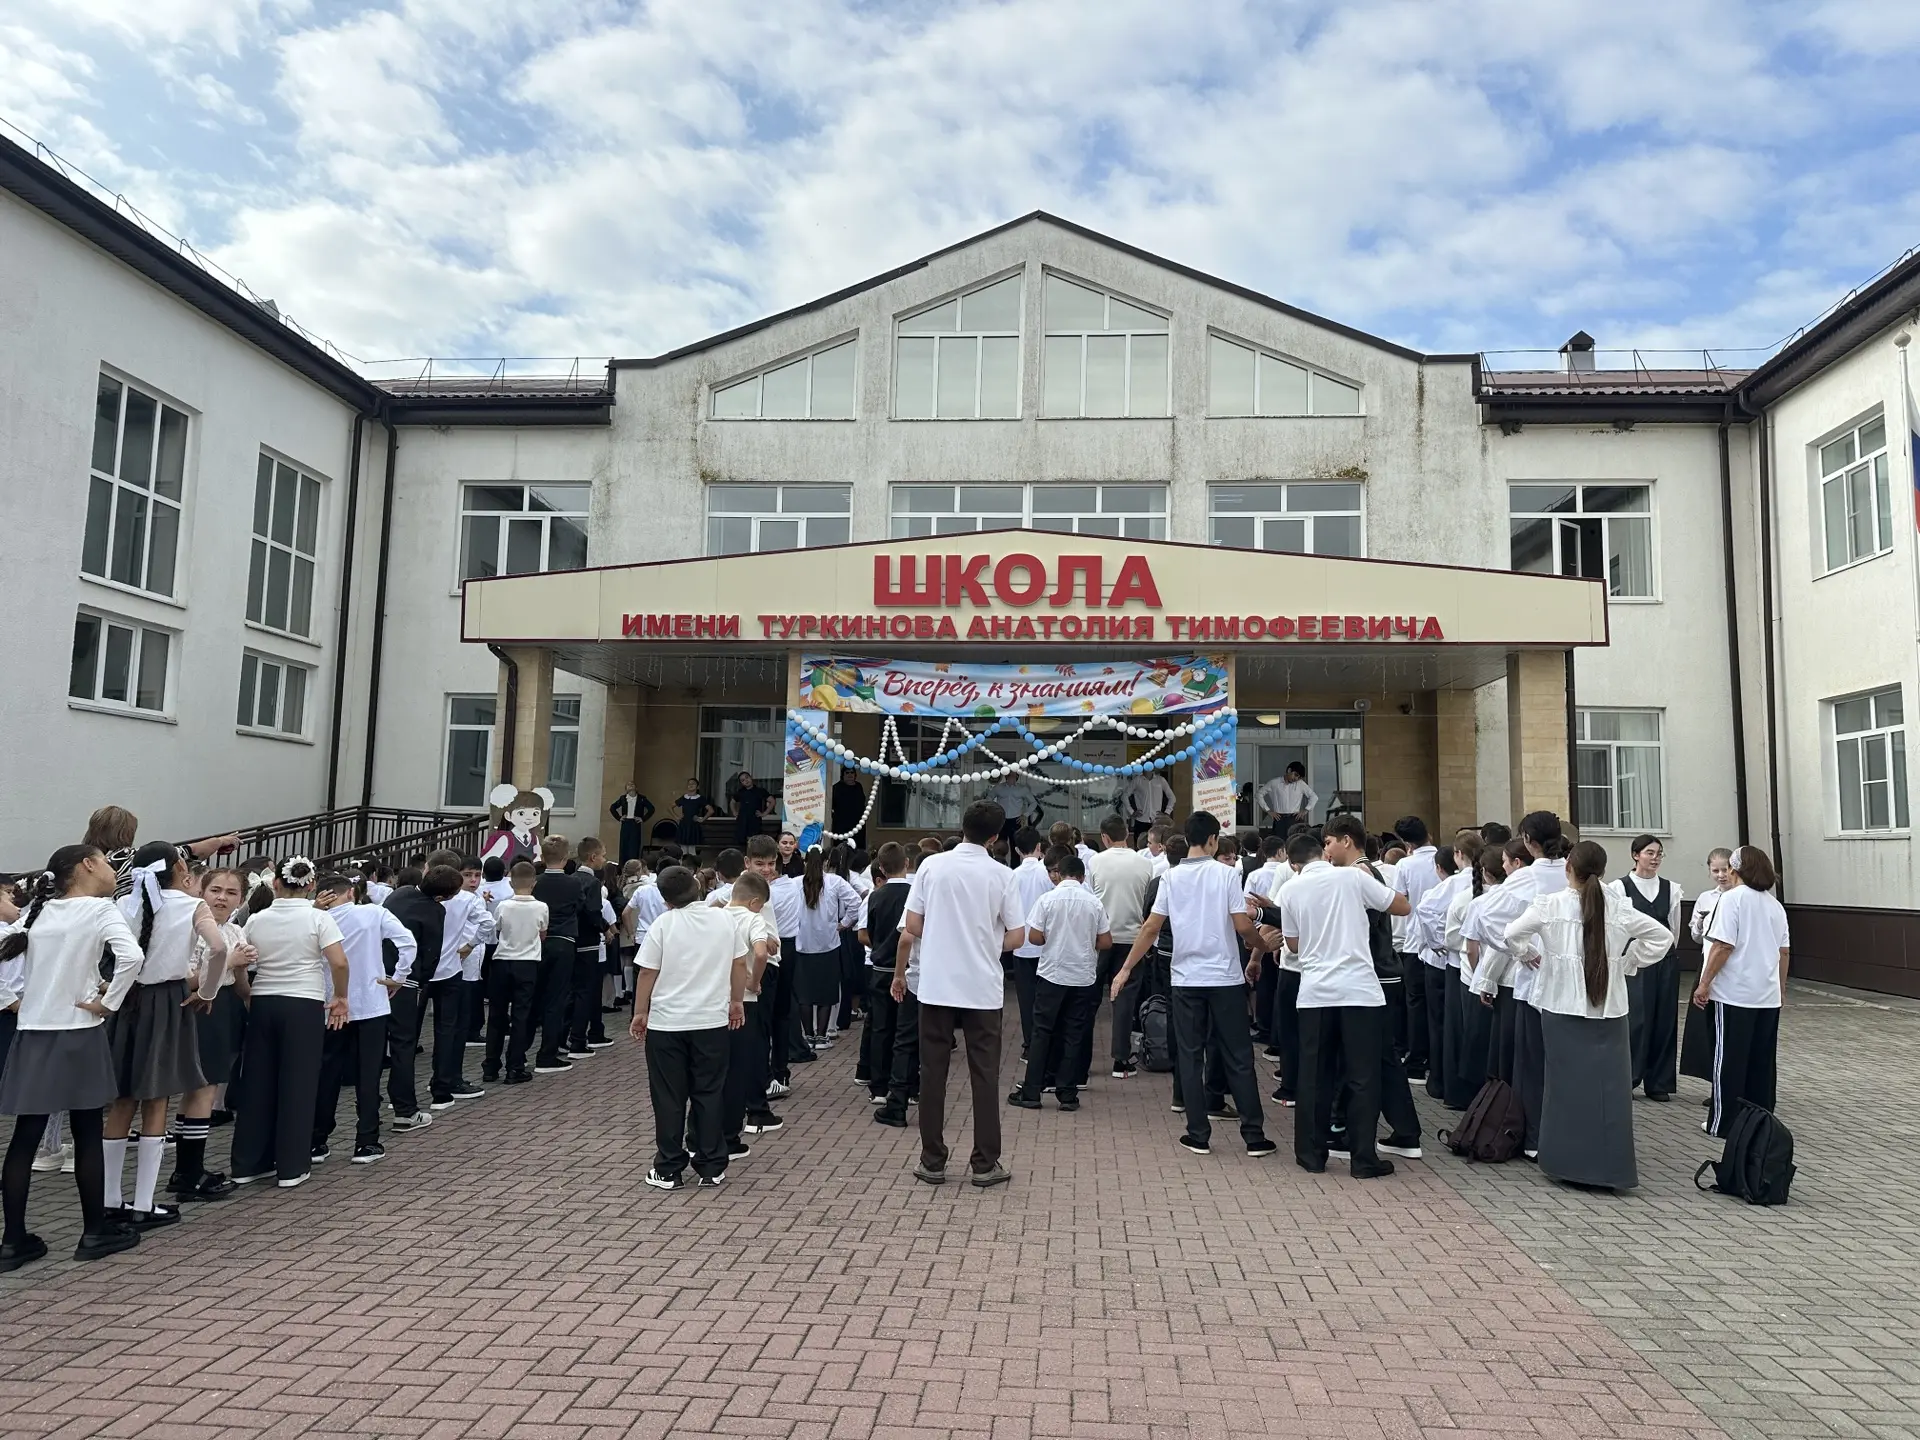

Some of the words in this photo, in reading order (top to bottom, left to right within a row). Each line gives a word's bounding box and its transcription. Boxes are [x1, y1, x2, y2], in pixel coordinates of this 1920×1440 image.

[874, 554, 1162, 608] ШКОЛА
[622, 613, 740, 637] ИМЕНИ
[757, 614, 957, 638] ТУРКИНОВА
[967, 614, 1154, 638] АНАТОЛИЯ
[1165, 614, 1444, 639] ТИМОФЕЕВИЧА
[883, 670, 981, 709] Вперёд,
[987, 681, 1004, 698] к
[999, 669, 1145, 709] знаниям!
